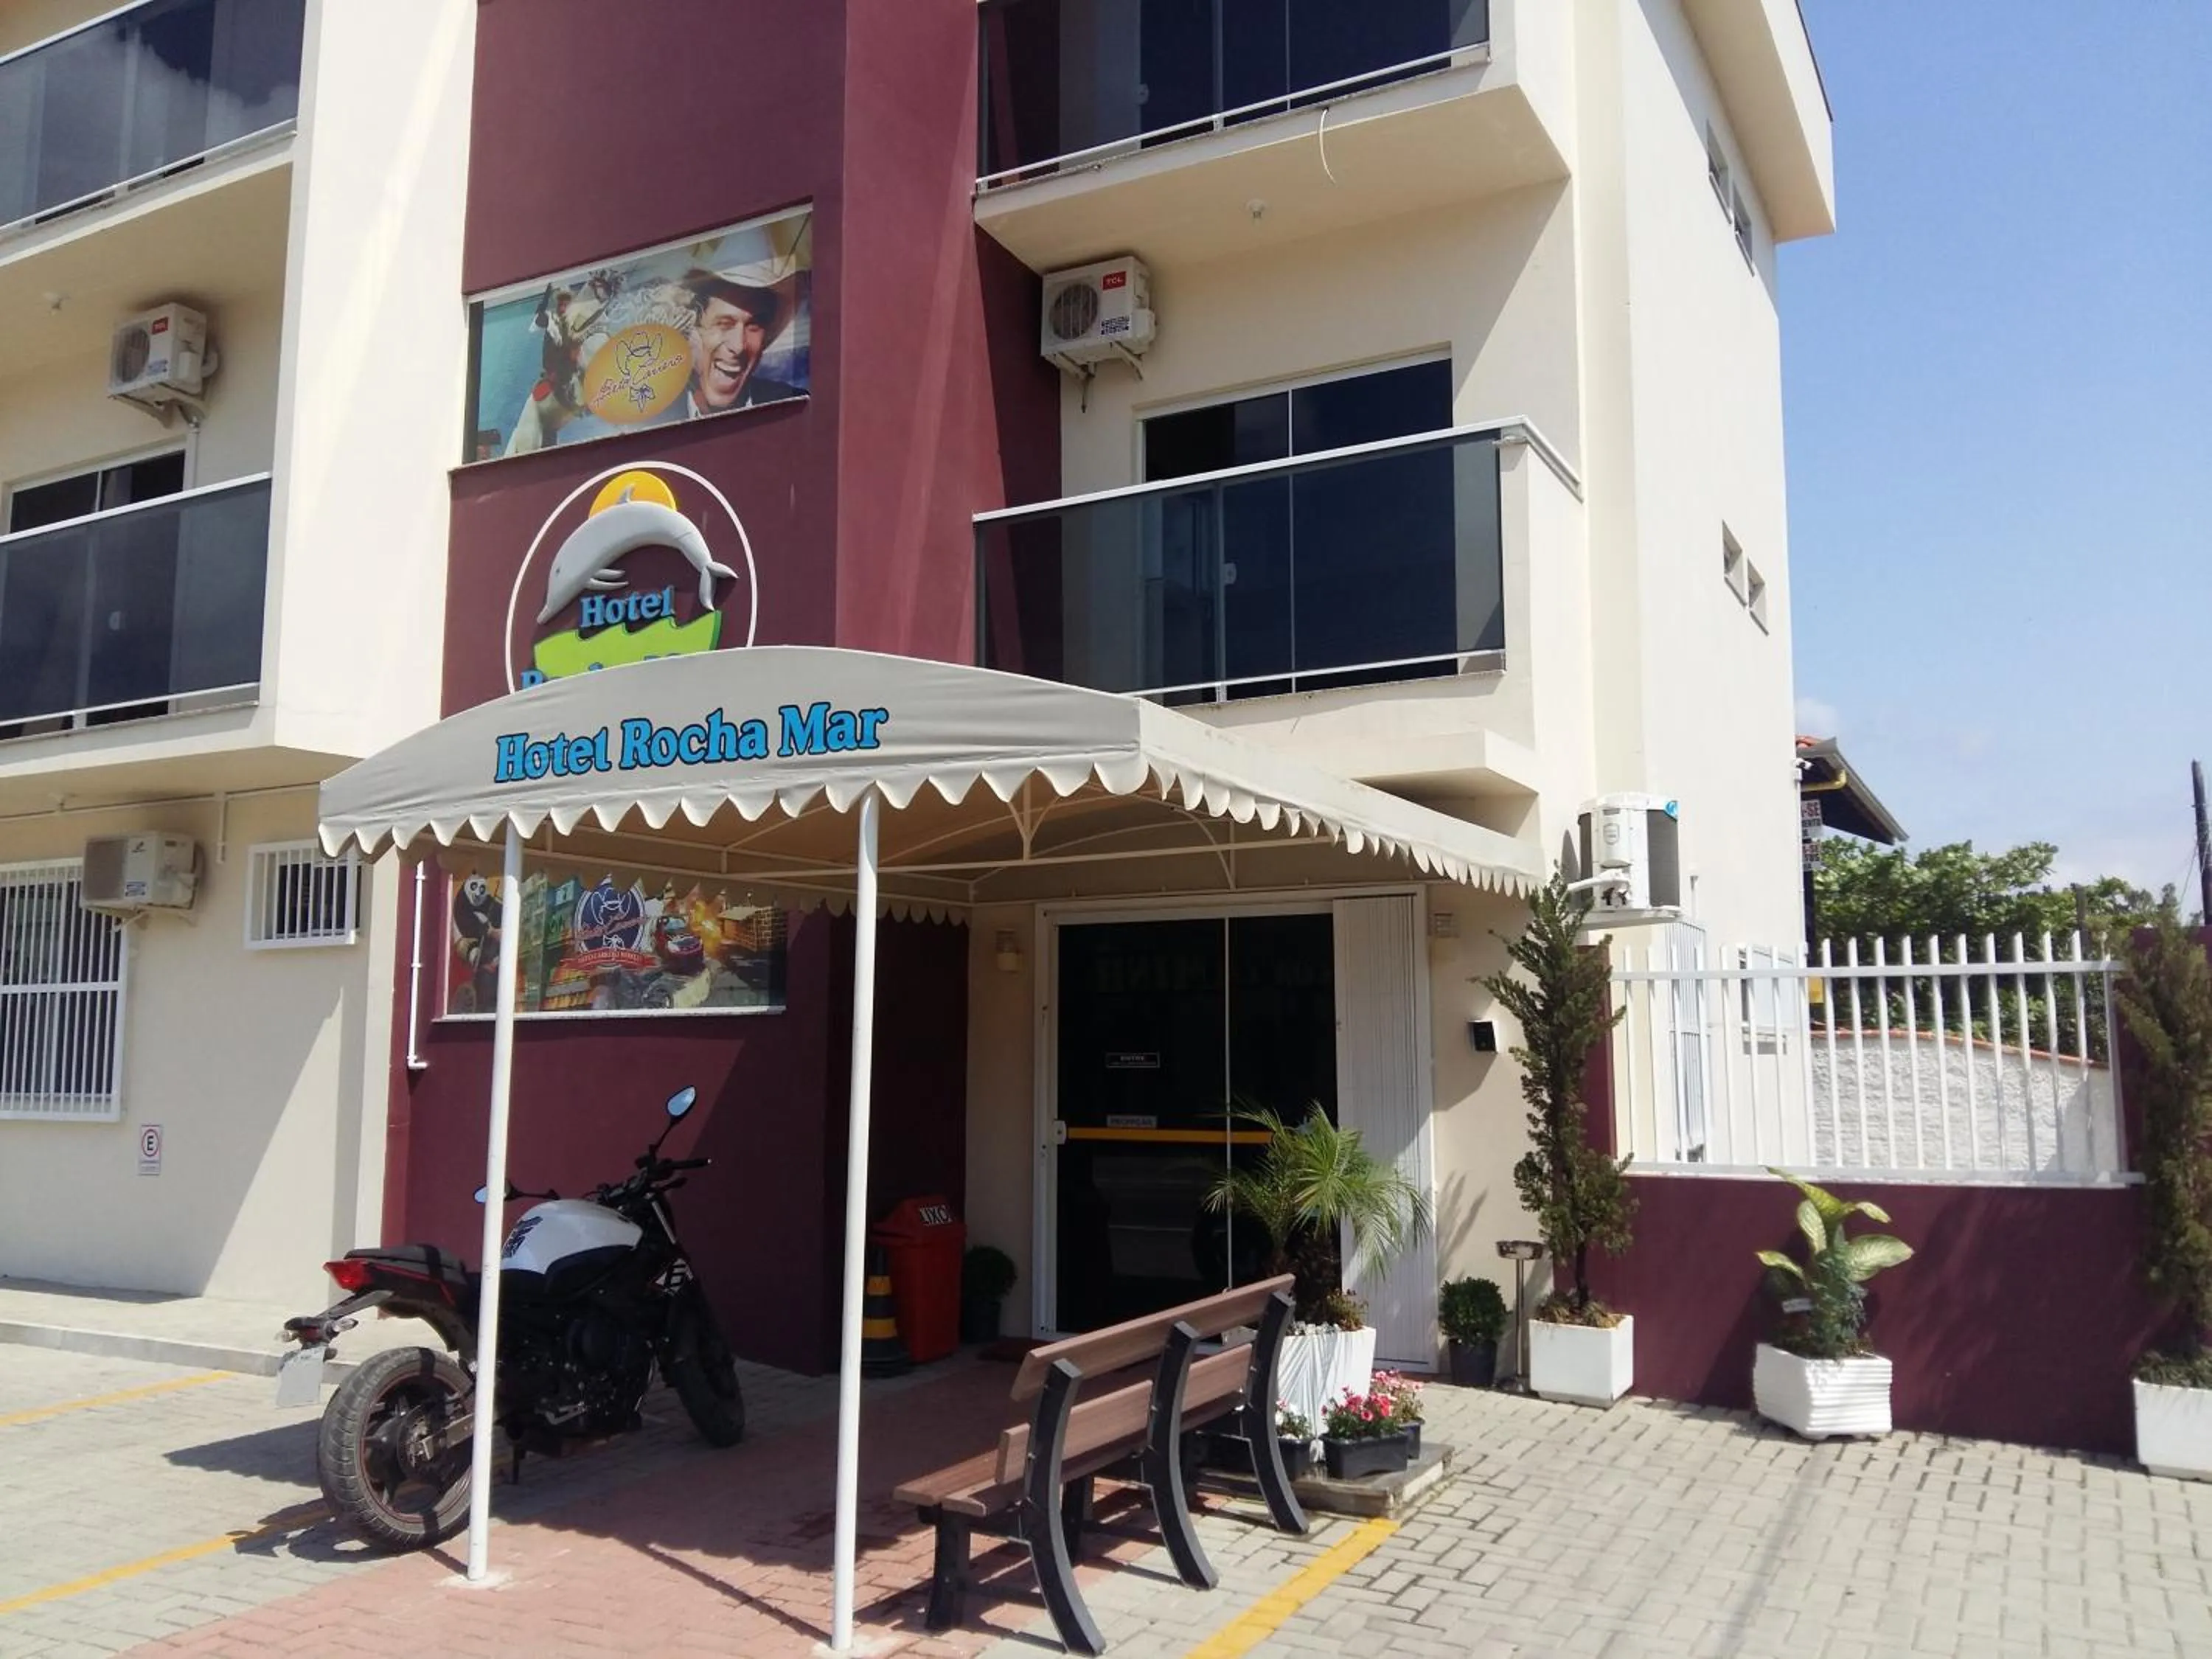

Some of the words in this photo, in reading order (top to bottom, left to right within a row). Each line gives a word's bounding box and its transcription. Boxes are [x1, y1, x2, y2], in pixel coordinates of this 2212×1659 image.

[580, 585, 675, 627] Hotel
[494, 726, 612, 783] Hotel
[619, 708, 769, 771] Rocha
[778, 701, 889, 757] Mar
[147, 1135, 154, 1151] E
